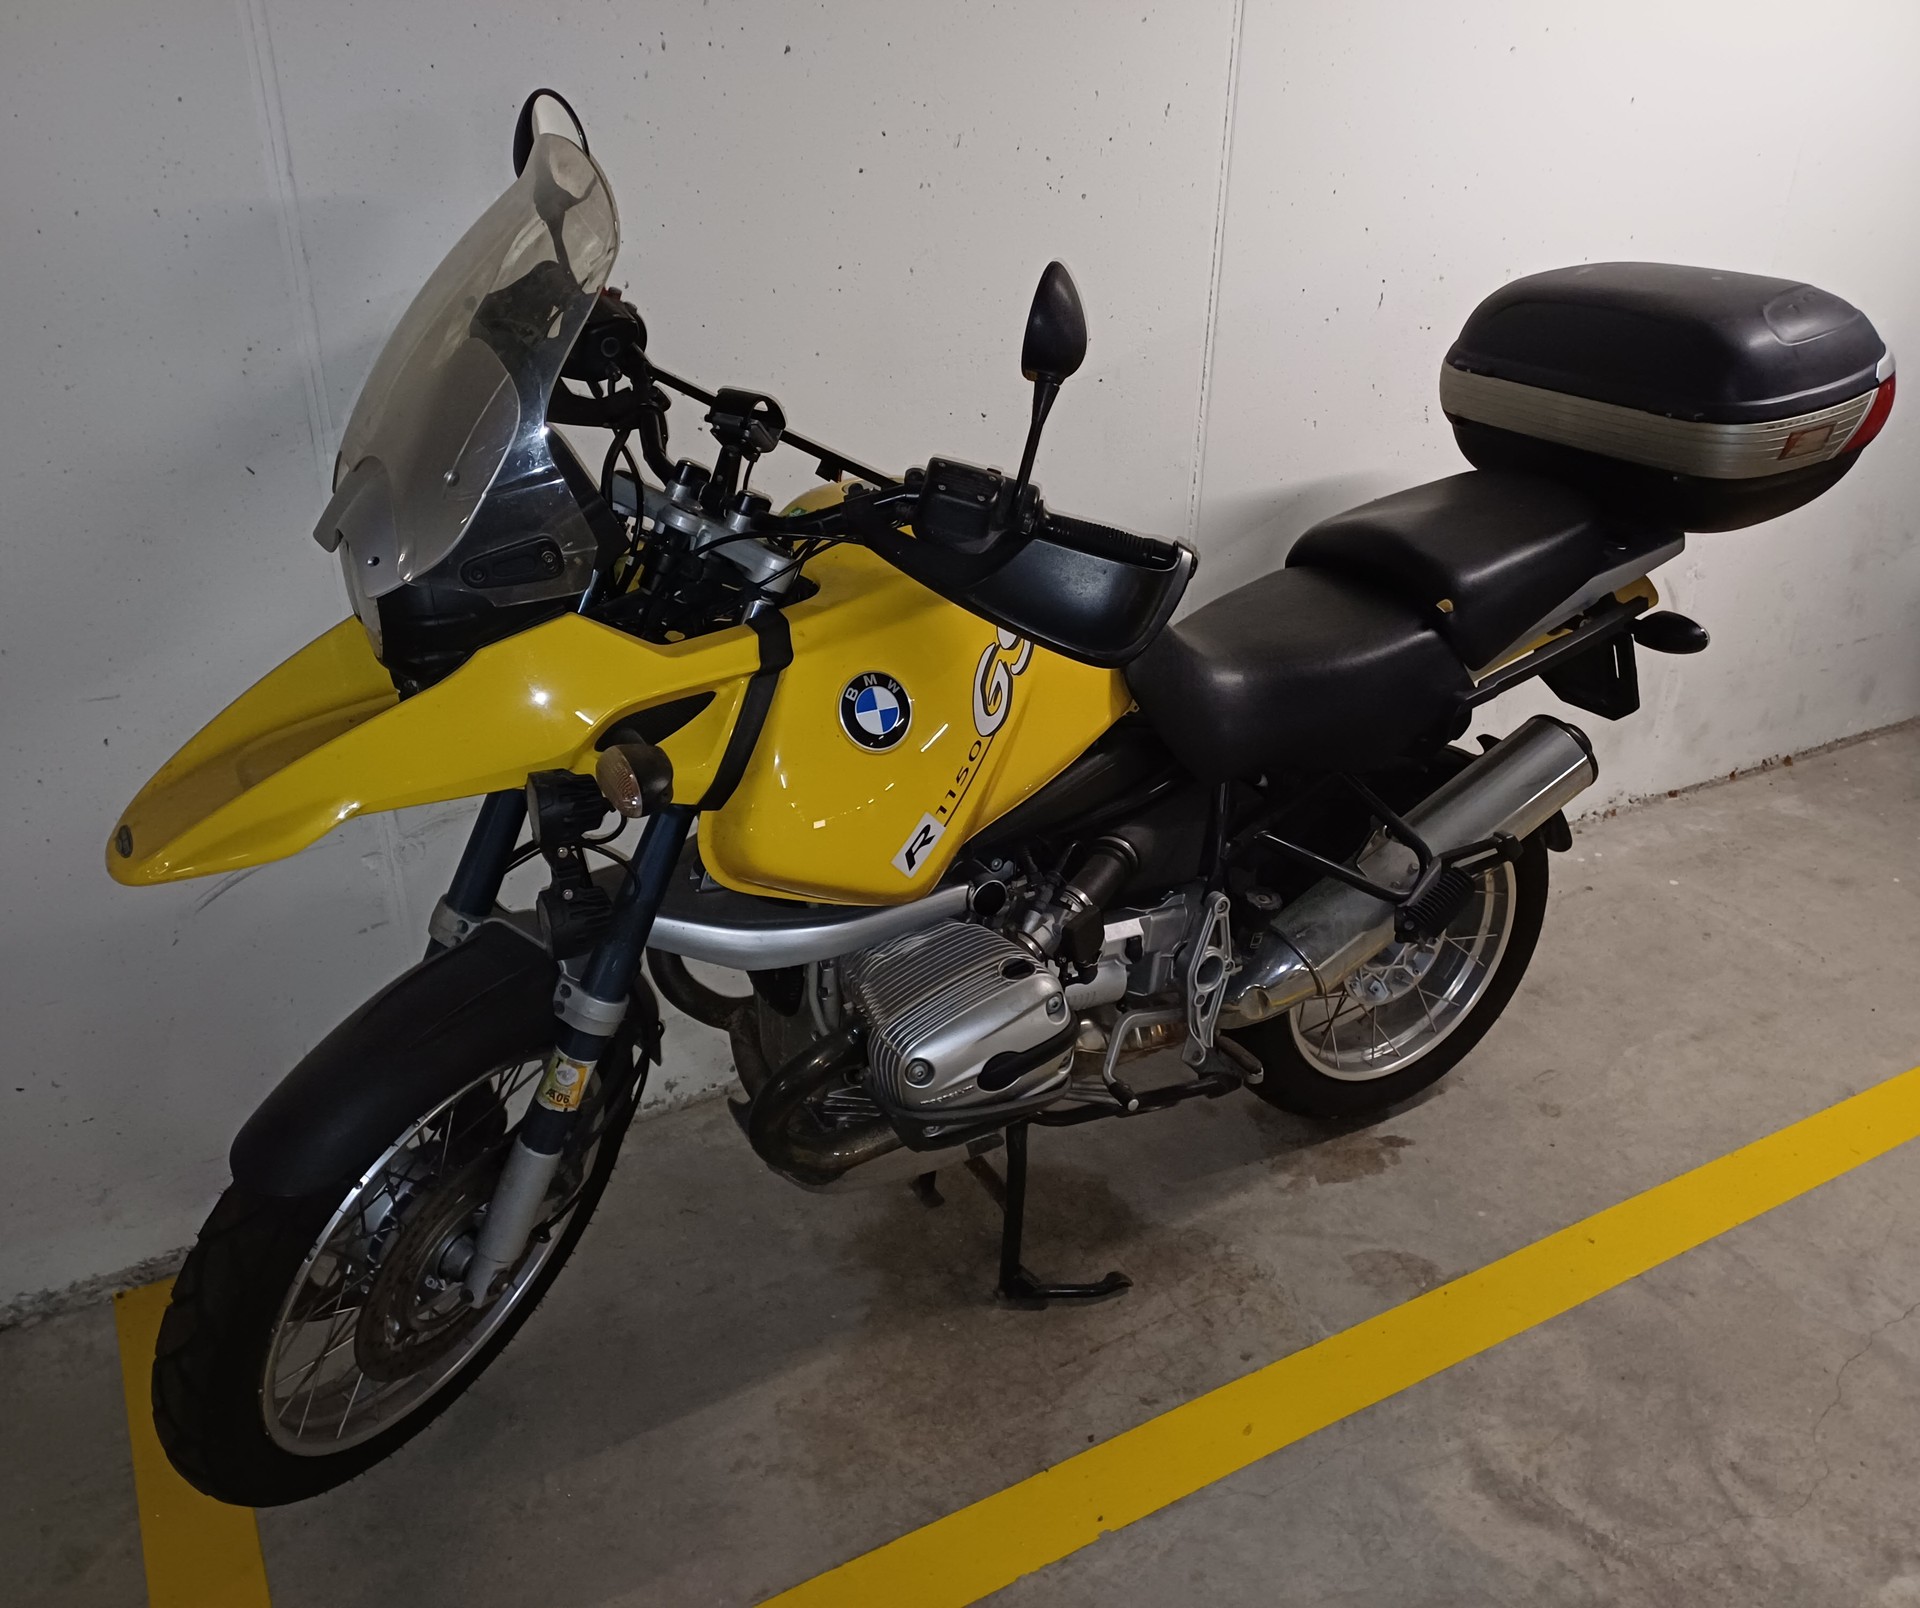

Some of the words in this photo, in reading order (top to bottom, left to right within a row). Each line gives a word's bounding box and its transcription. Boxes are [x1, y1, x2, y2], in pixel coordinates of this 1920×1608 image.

[845, 674, 900, 702] BMW
[904, 824, 936, 871] R
[935, 740, 982, 815] 1150
